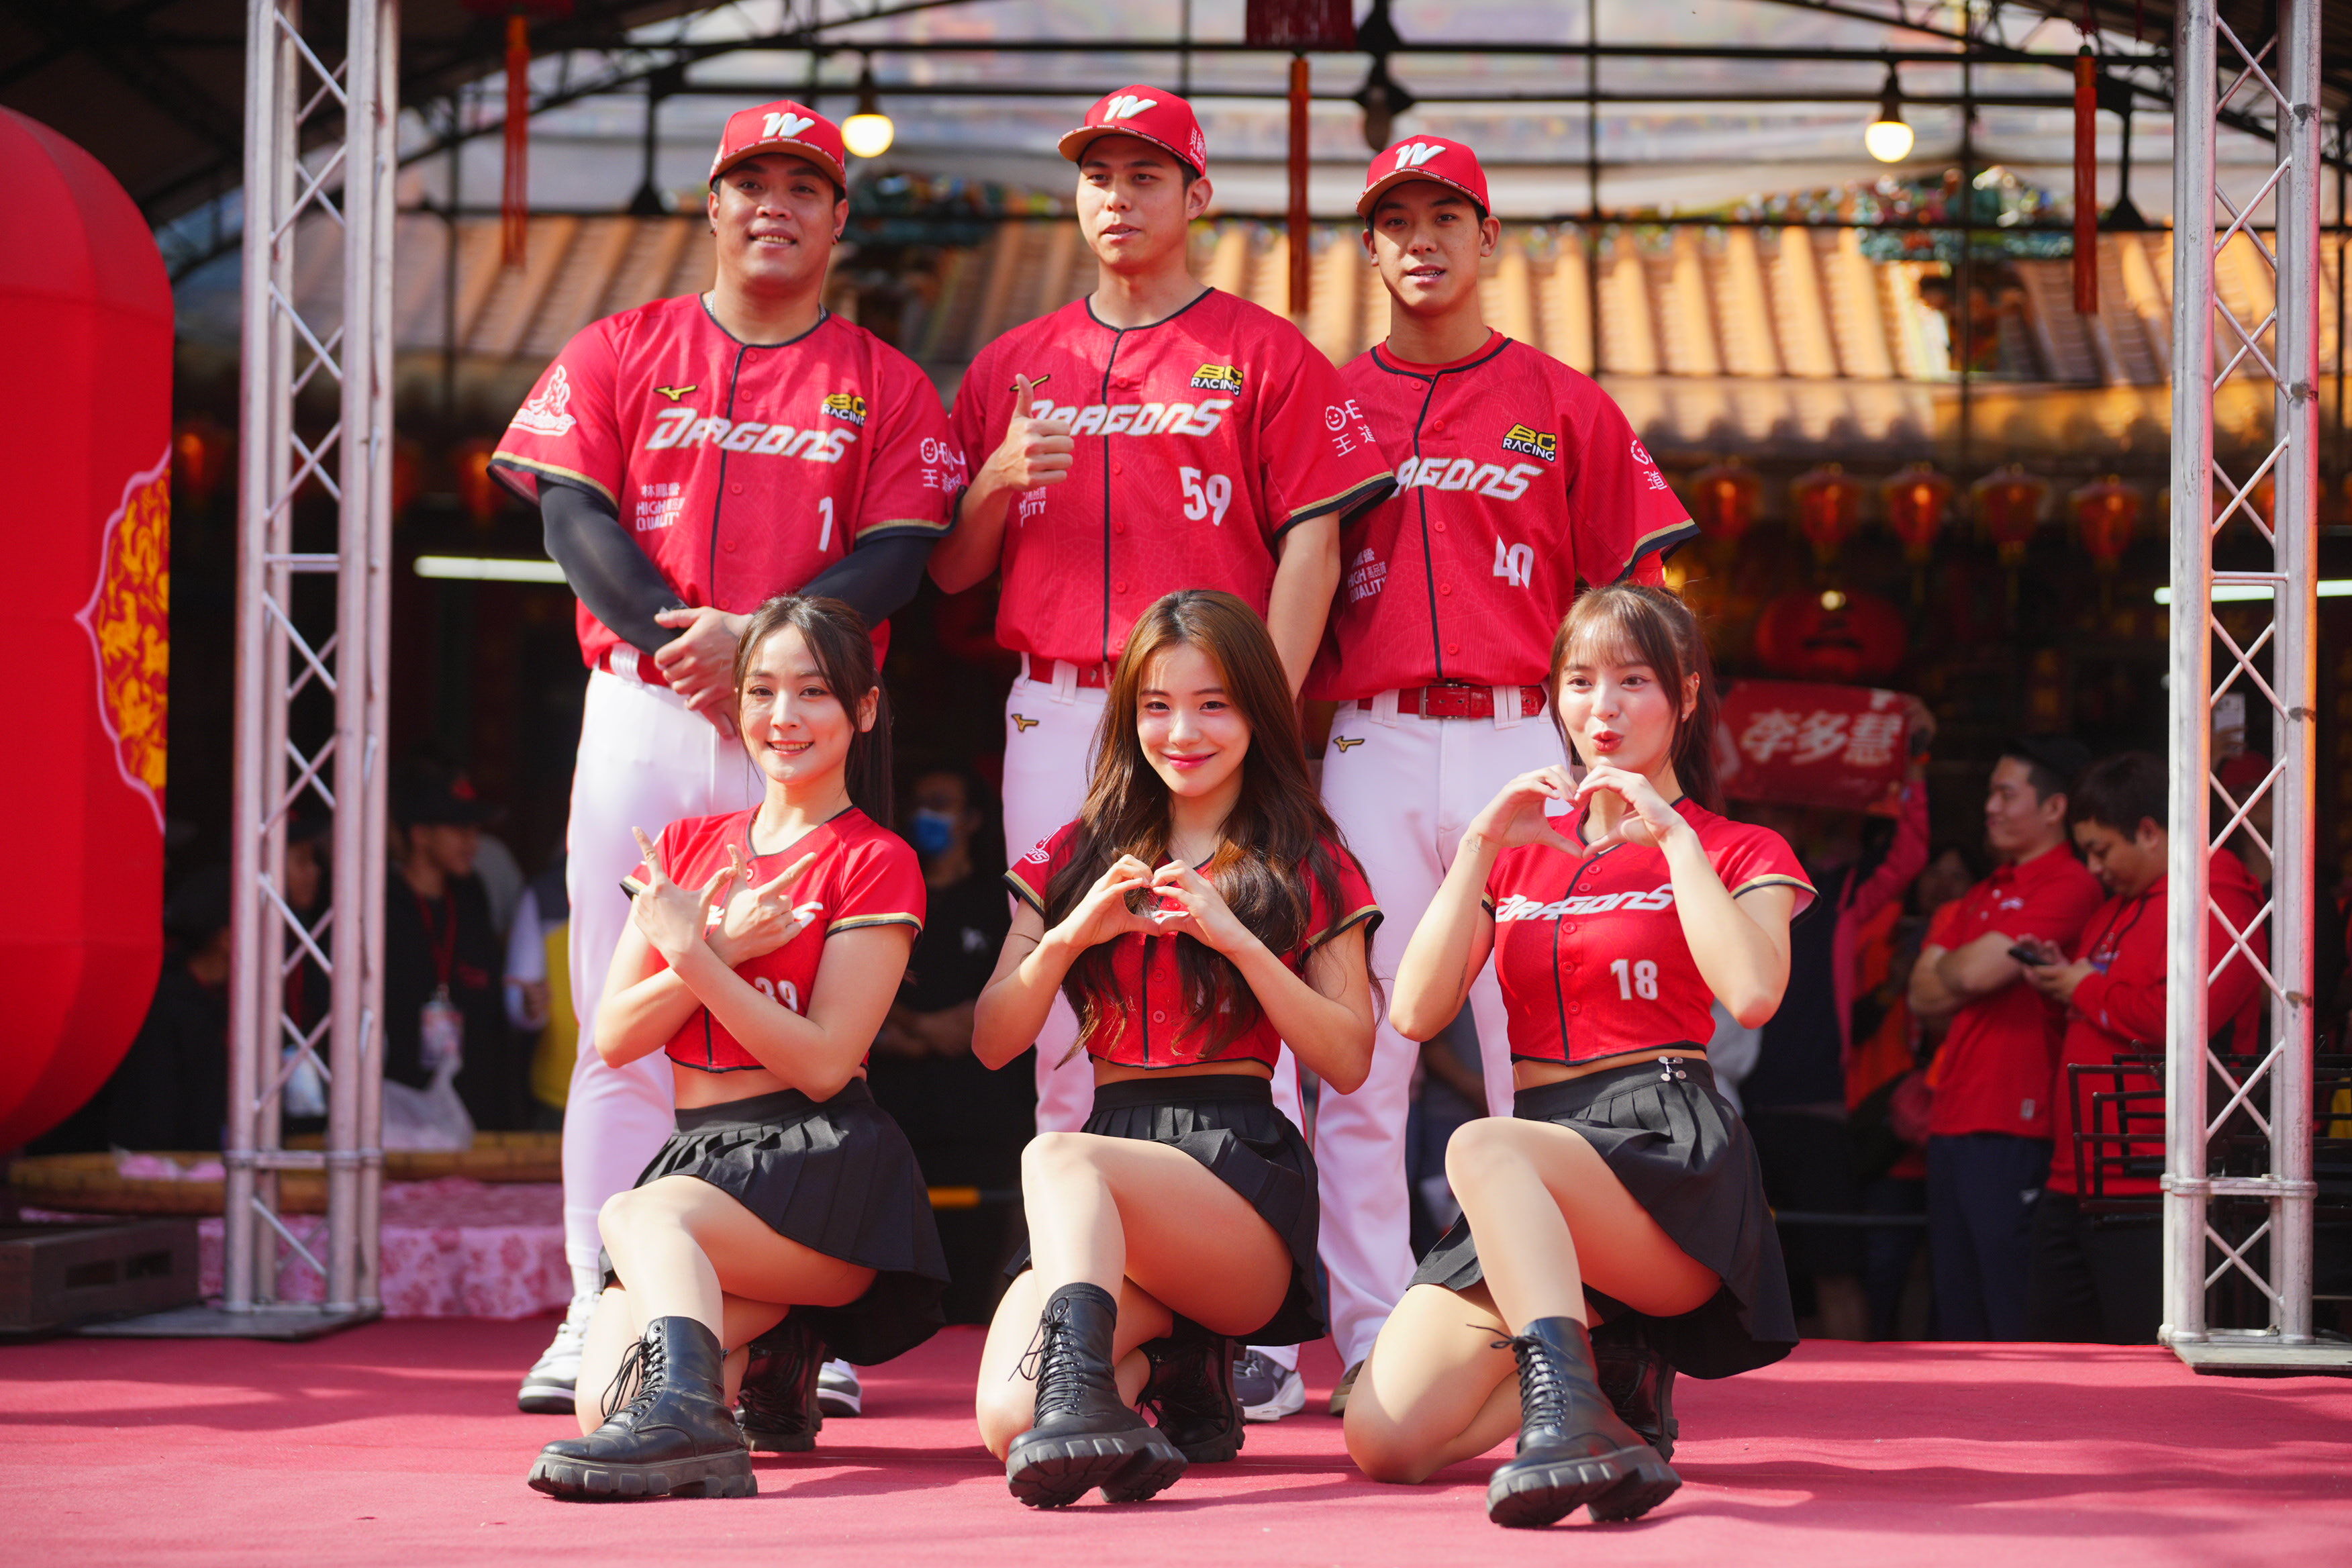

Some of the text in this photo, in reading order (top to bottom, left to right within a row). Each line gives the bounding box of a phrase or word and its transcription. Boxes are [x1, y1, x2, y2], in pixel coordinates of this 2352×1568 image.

[1190, 377, 1240, 396] RACING
[1192, 362, 1244, 385] BC
[822, 393, 867, 417] BC
[645, 407, 857, 463] DRAGONS
[1502, 437, 1555, 462] RACING
[1506, 424, 1557, 452] BC
[1179, 466, 1232, 526] 59
[818, 495, 834, 552] 1
[1492, 533, 1534, 589] 40
[1739, 709, 1903, 767] 李多慧
[1495, 883, 1674, 923] DRAGONS
[1610, 959, 1659, 1000] 18
